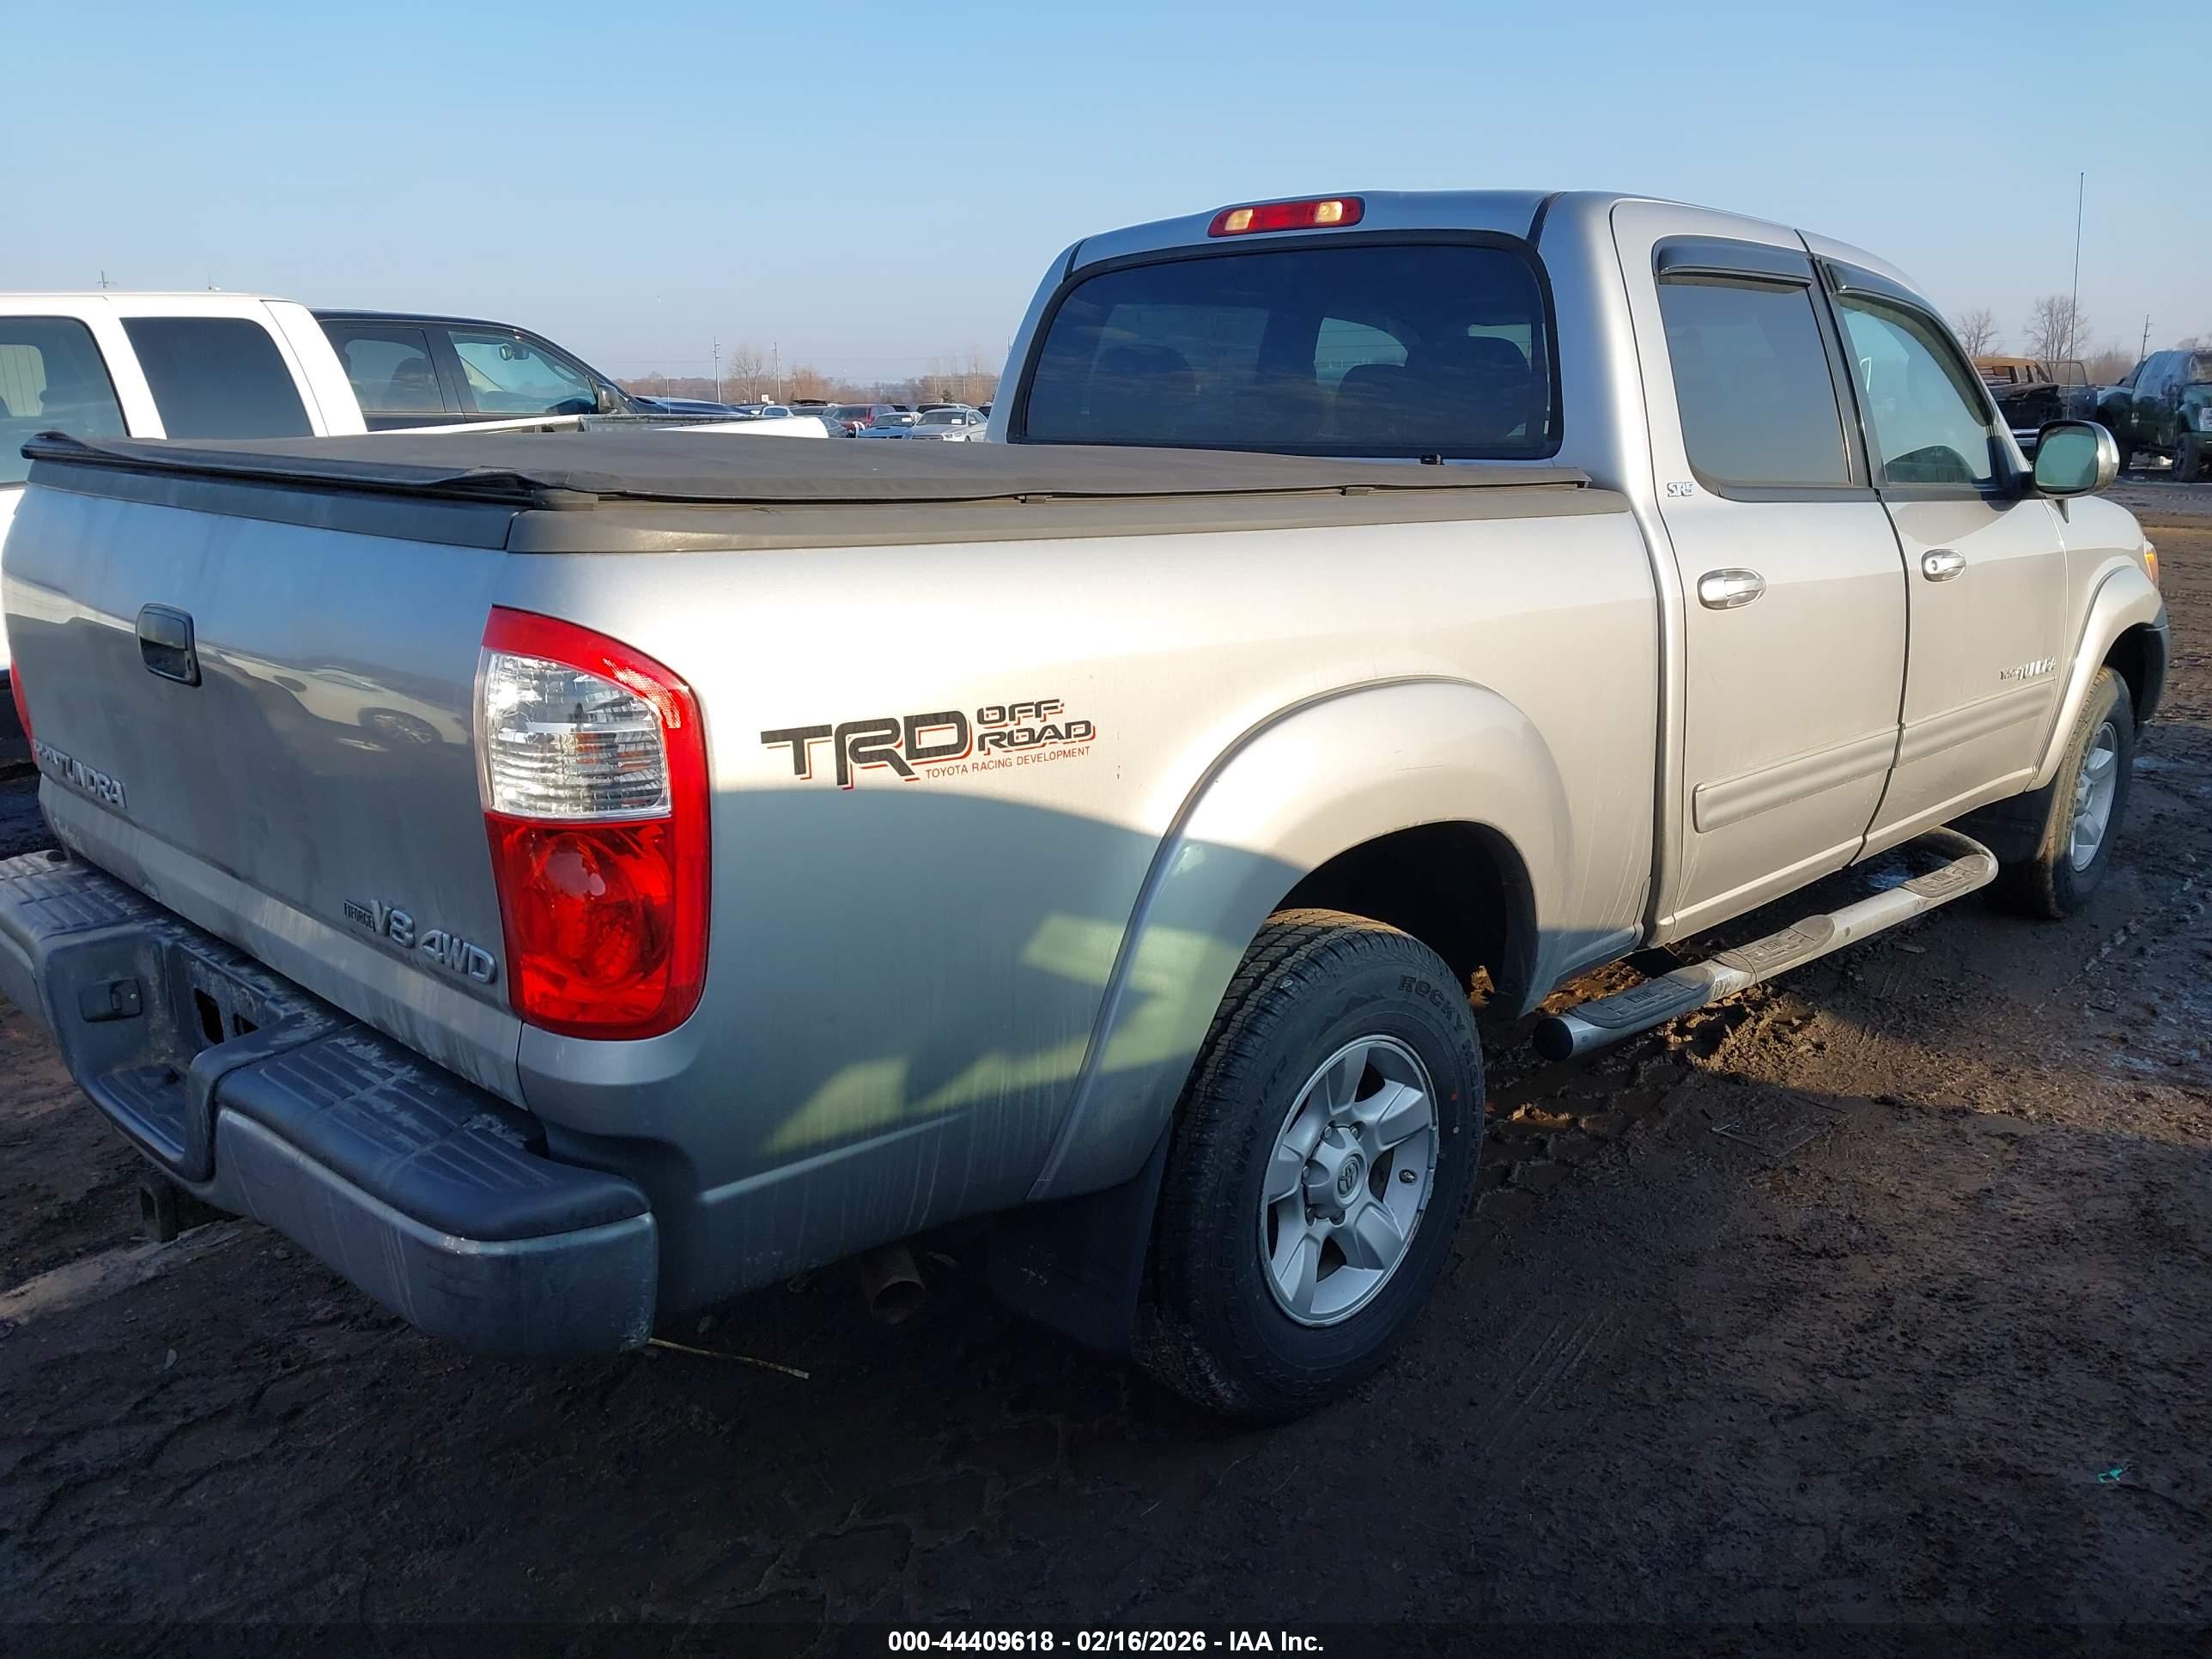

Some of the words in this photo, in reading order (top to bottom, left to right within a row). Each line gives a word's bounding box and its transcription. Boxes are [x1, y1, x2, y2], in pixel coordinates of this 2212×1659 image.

[761, 710, 972, 790] TRD
[977, 698, 1064, 728] OFF
[926, 764, 969, 779] TOYOTA
[972, 757, 1013, 772] RACING
[1016, 745, 1091, 769] DEVELOPMENT
[977, 720, 1096, 756] ROAD
[54, 748, 127, 809] TUNDRA
[371, 899, 415, 948] V8
[419, 929, 495, 983] 4WD
